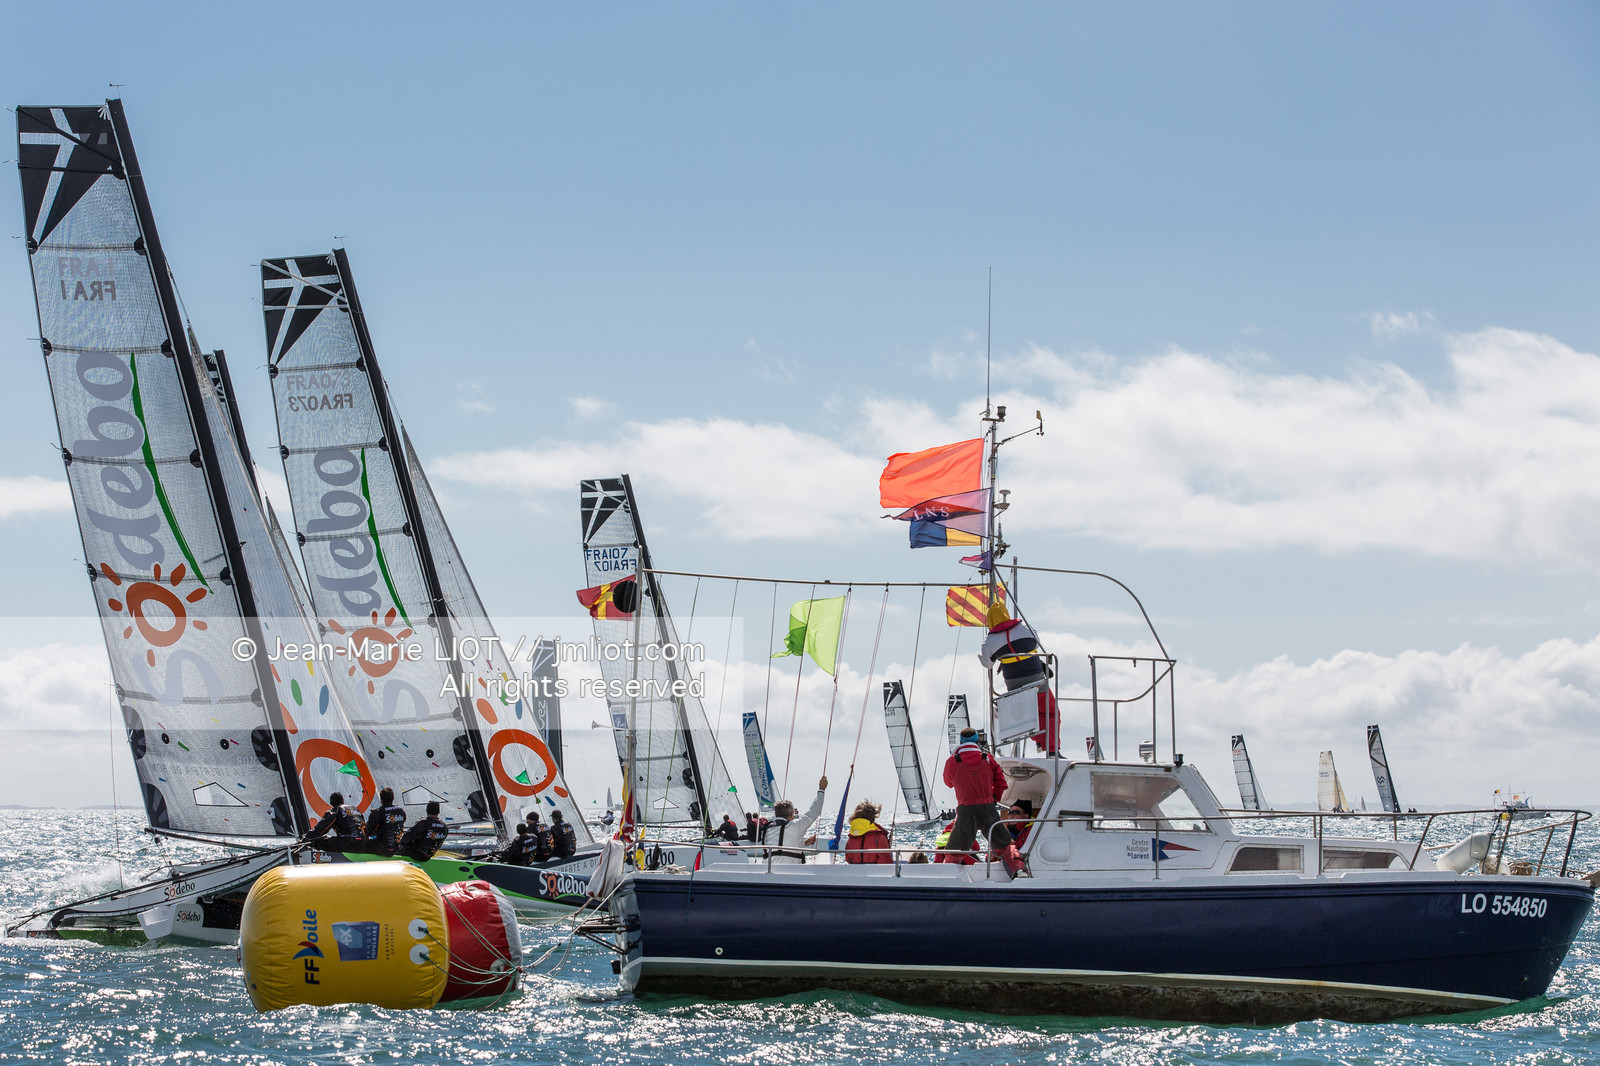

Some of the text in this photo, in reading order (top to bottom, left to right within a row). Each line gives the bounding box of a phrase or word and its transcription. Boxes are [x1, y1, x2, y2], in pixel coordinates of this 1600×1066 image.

[164, 880, 196, 901] Sodebo
[539, 871, 587, 898] Sodebo
[176, 909, 201, 923] Sodebo
[1461, 893, 1548, 918] LO 554850
